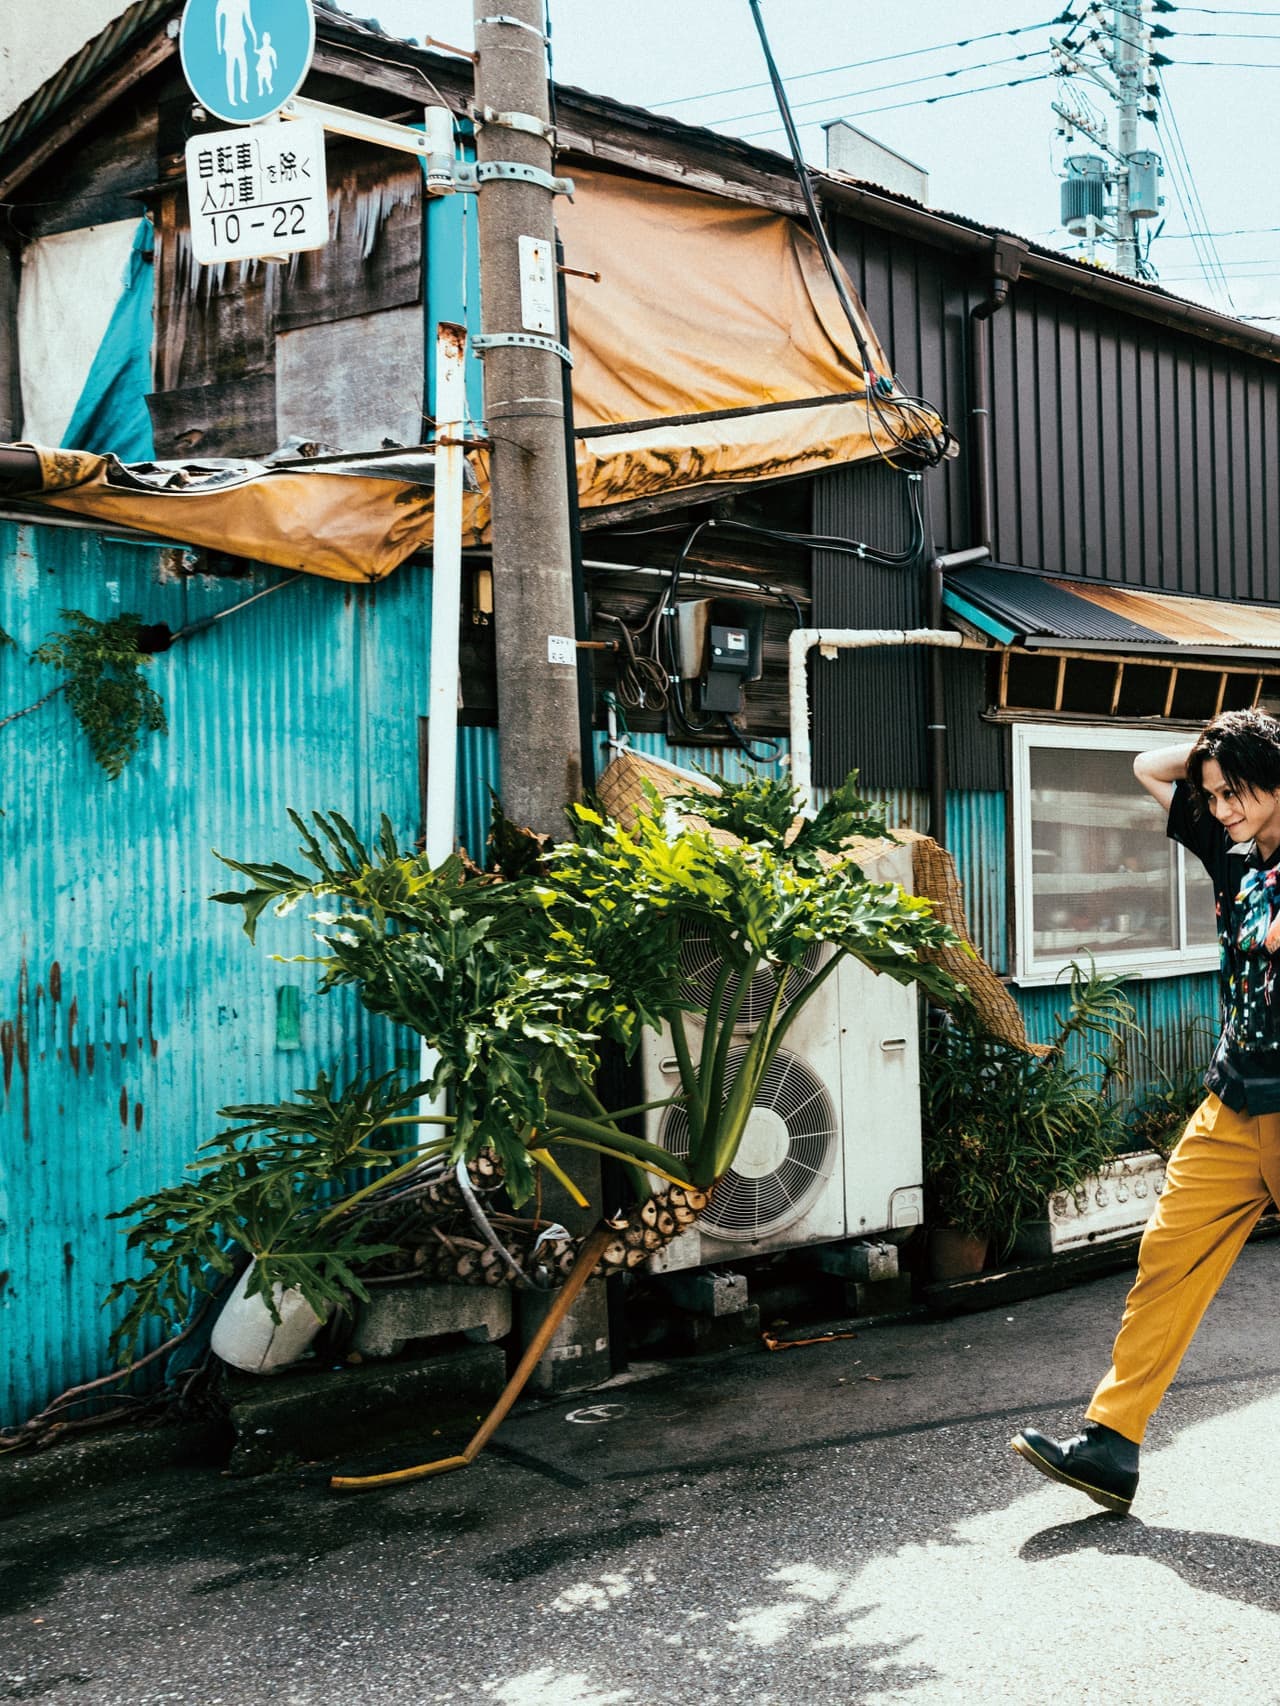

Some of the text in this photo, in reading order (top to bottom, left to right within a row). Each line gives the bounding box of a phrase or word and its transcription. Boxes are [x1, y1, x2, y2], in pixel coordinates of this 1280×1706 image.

[198, 142, 253, 179] 自転車
[201, 176, 255, 212] 人力車
